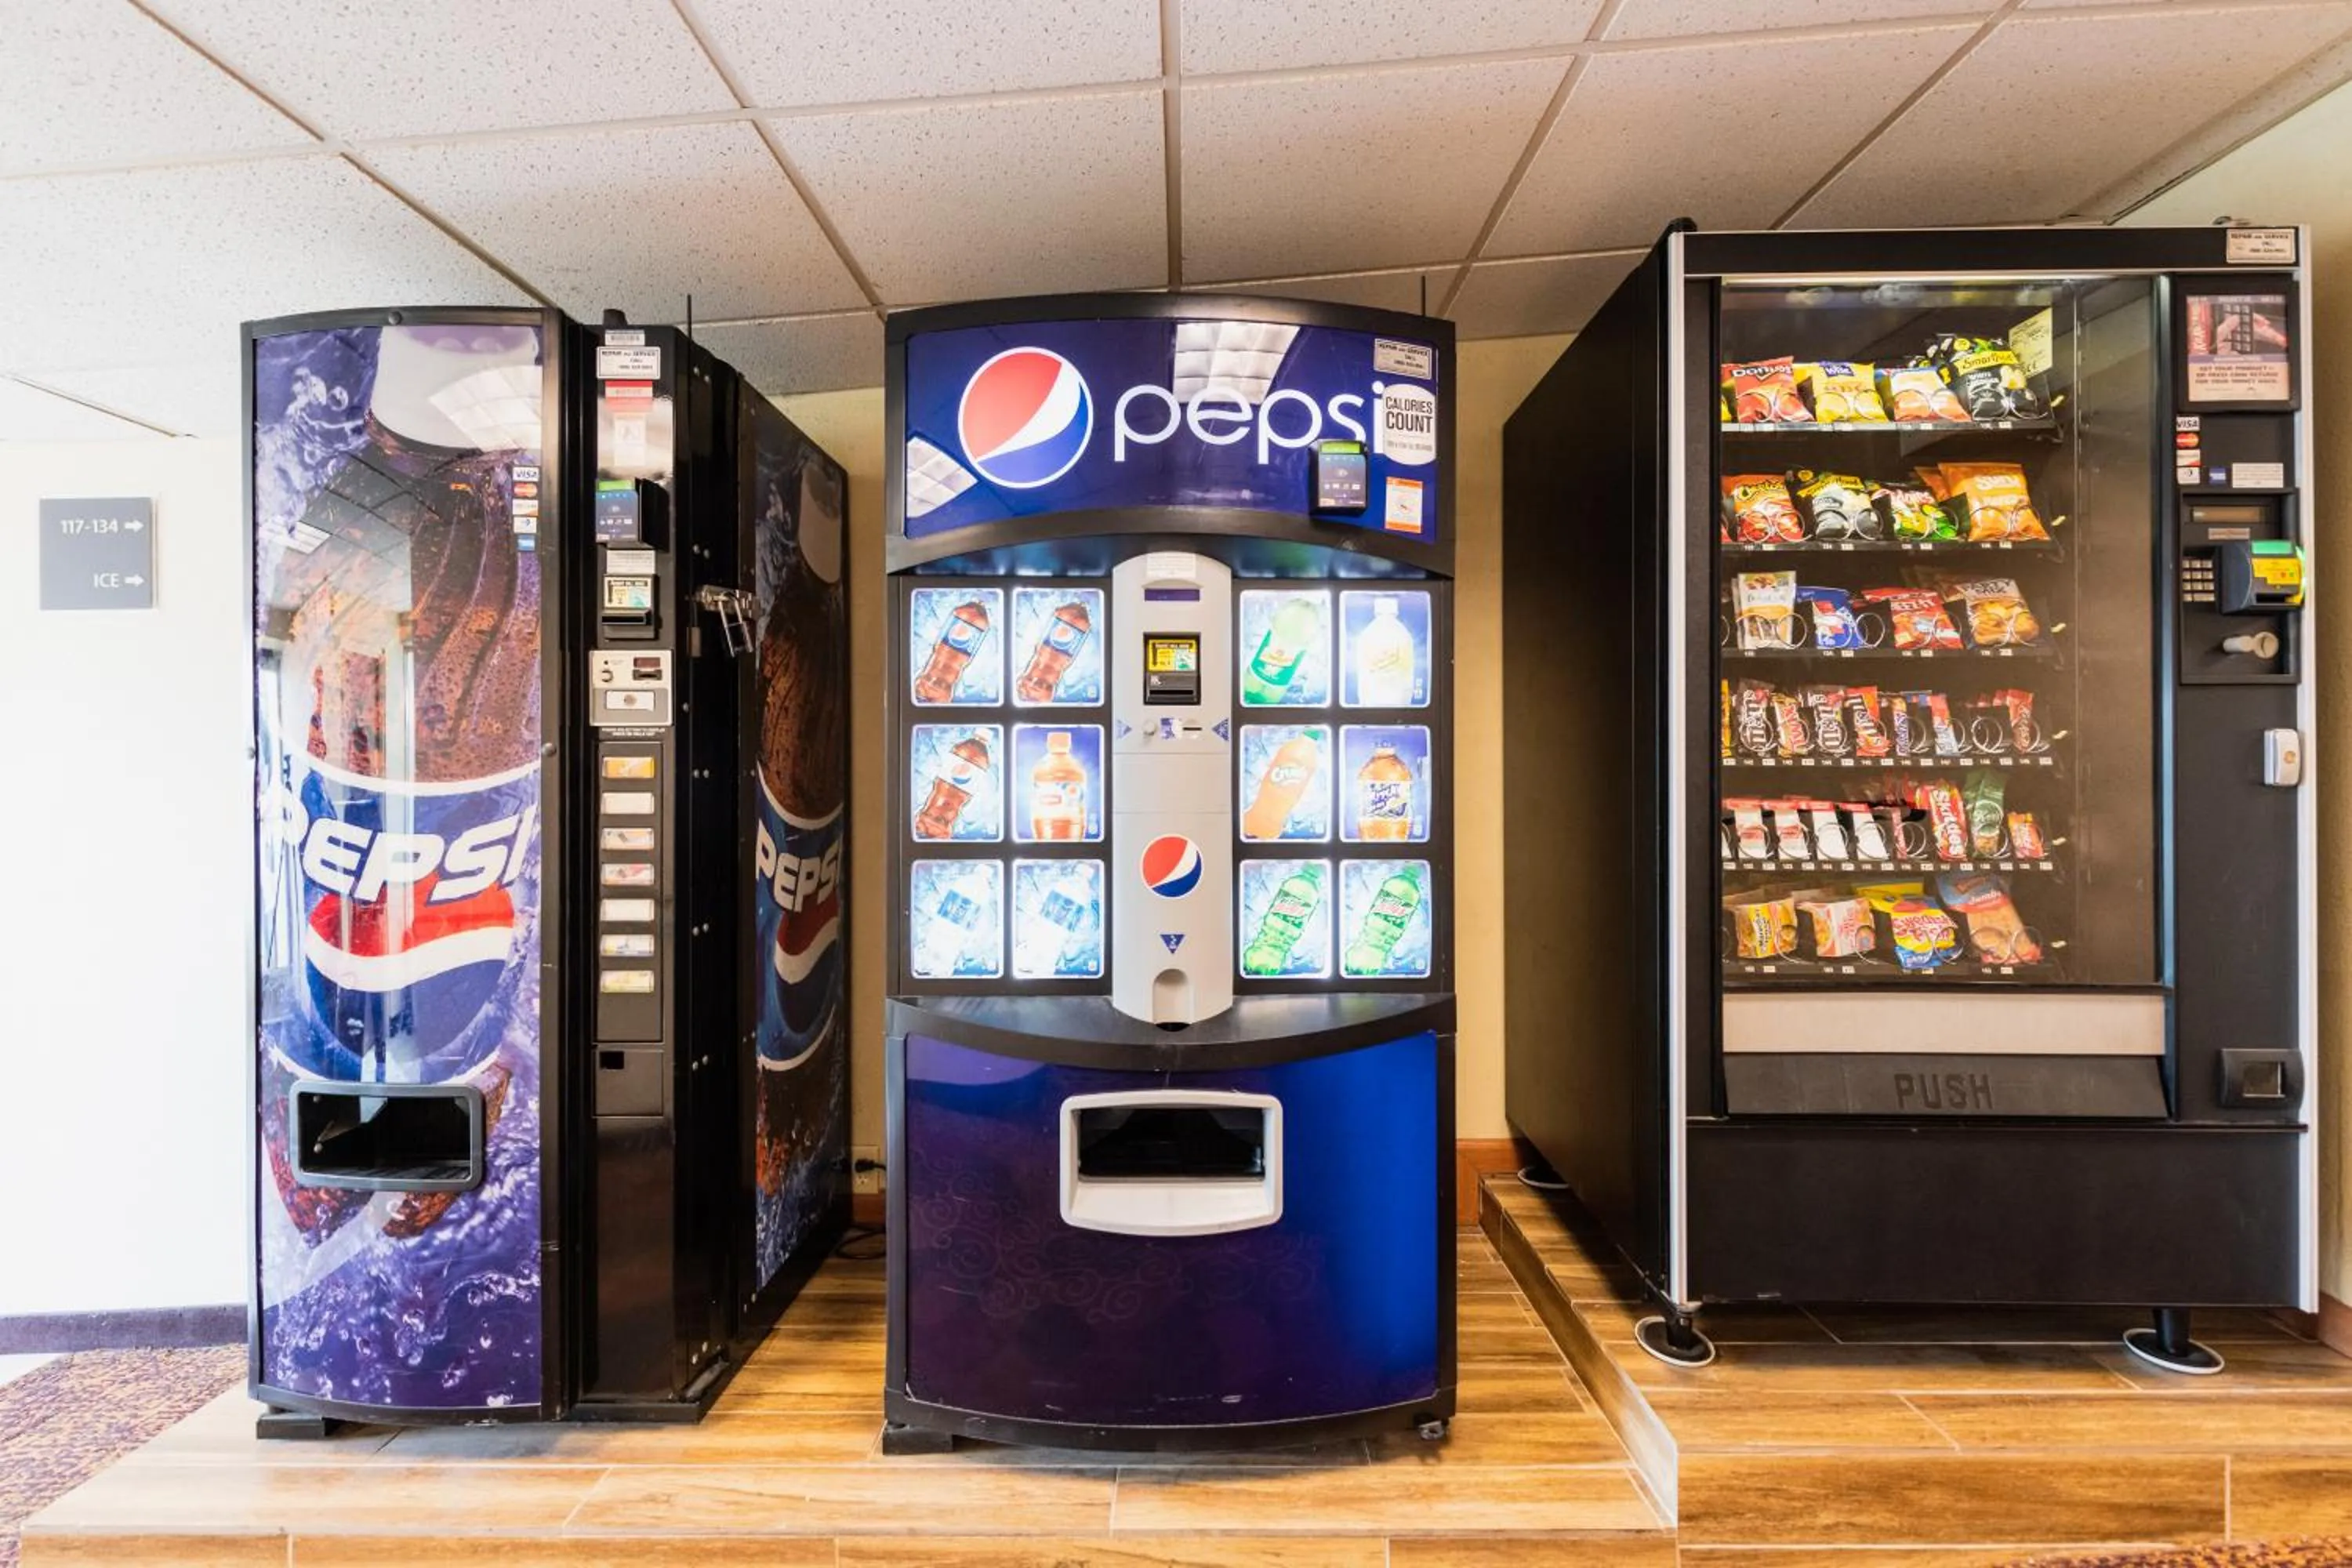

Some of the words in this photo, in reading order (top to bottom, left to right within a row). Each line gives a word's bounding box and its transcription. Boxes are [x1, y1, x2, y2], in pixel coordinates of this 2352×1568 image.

[1386, 396, 1432, 415] CALORIES
[1114, 381, 1384, 464] pepsi
[1386, 411, 1433, 434] COUNT
[60, 520, 118, 534] 117-134
[94, 573, 119, 588] ICE
[260, 784, 538, 904] PEPSI
[1894, 1073, 1993, 1109] PUSH
